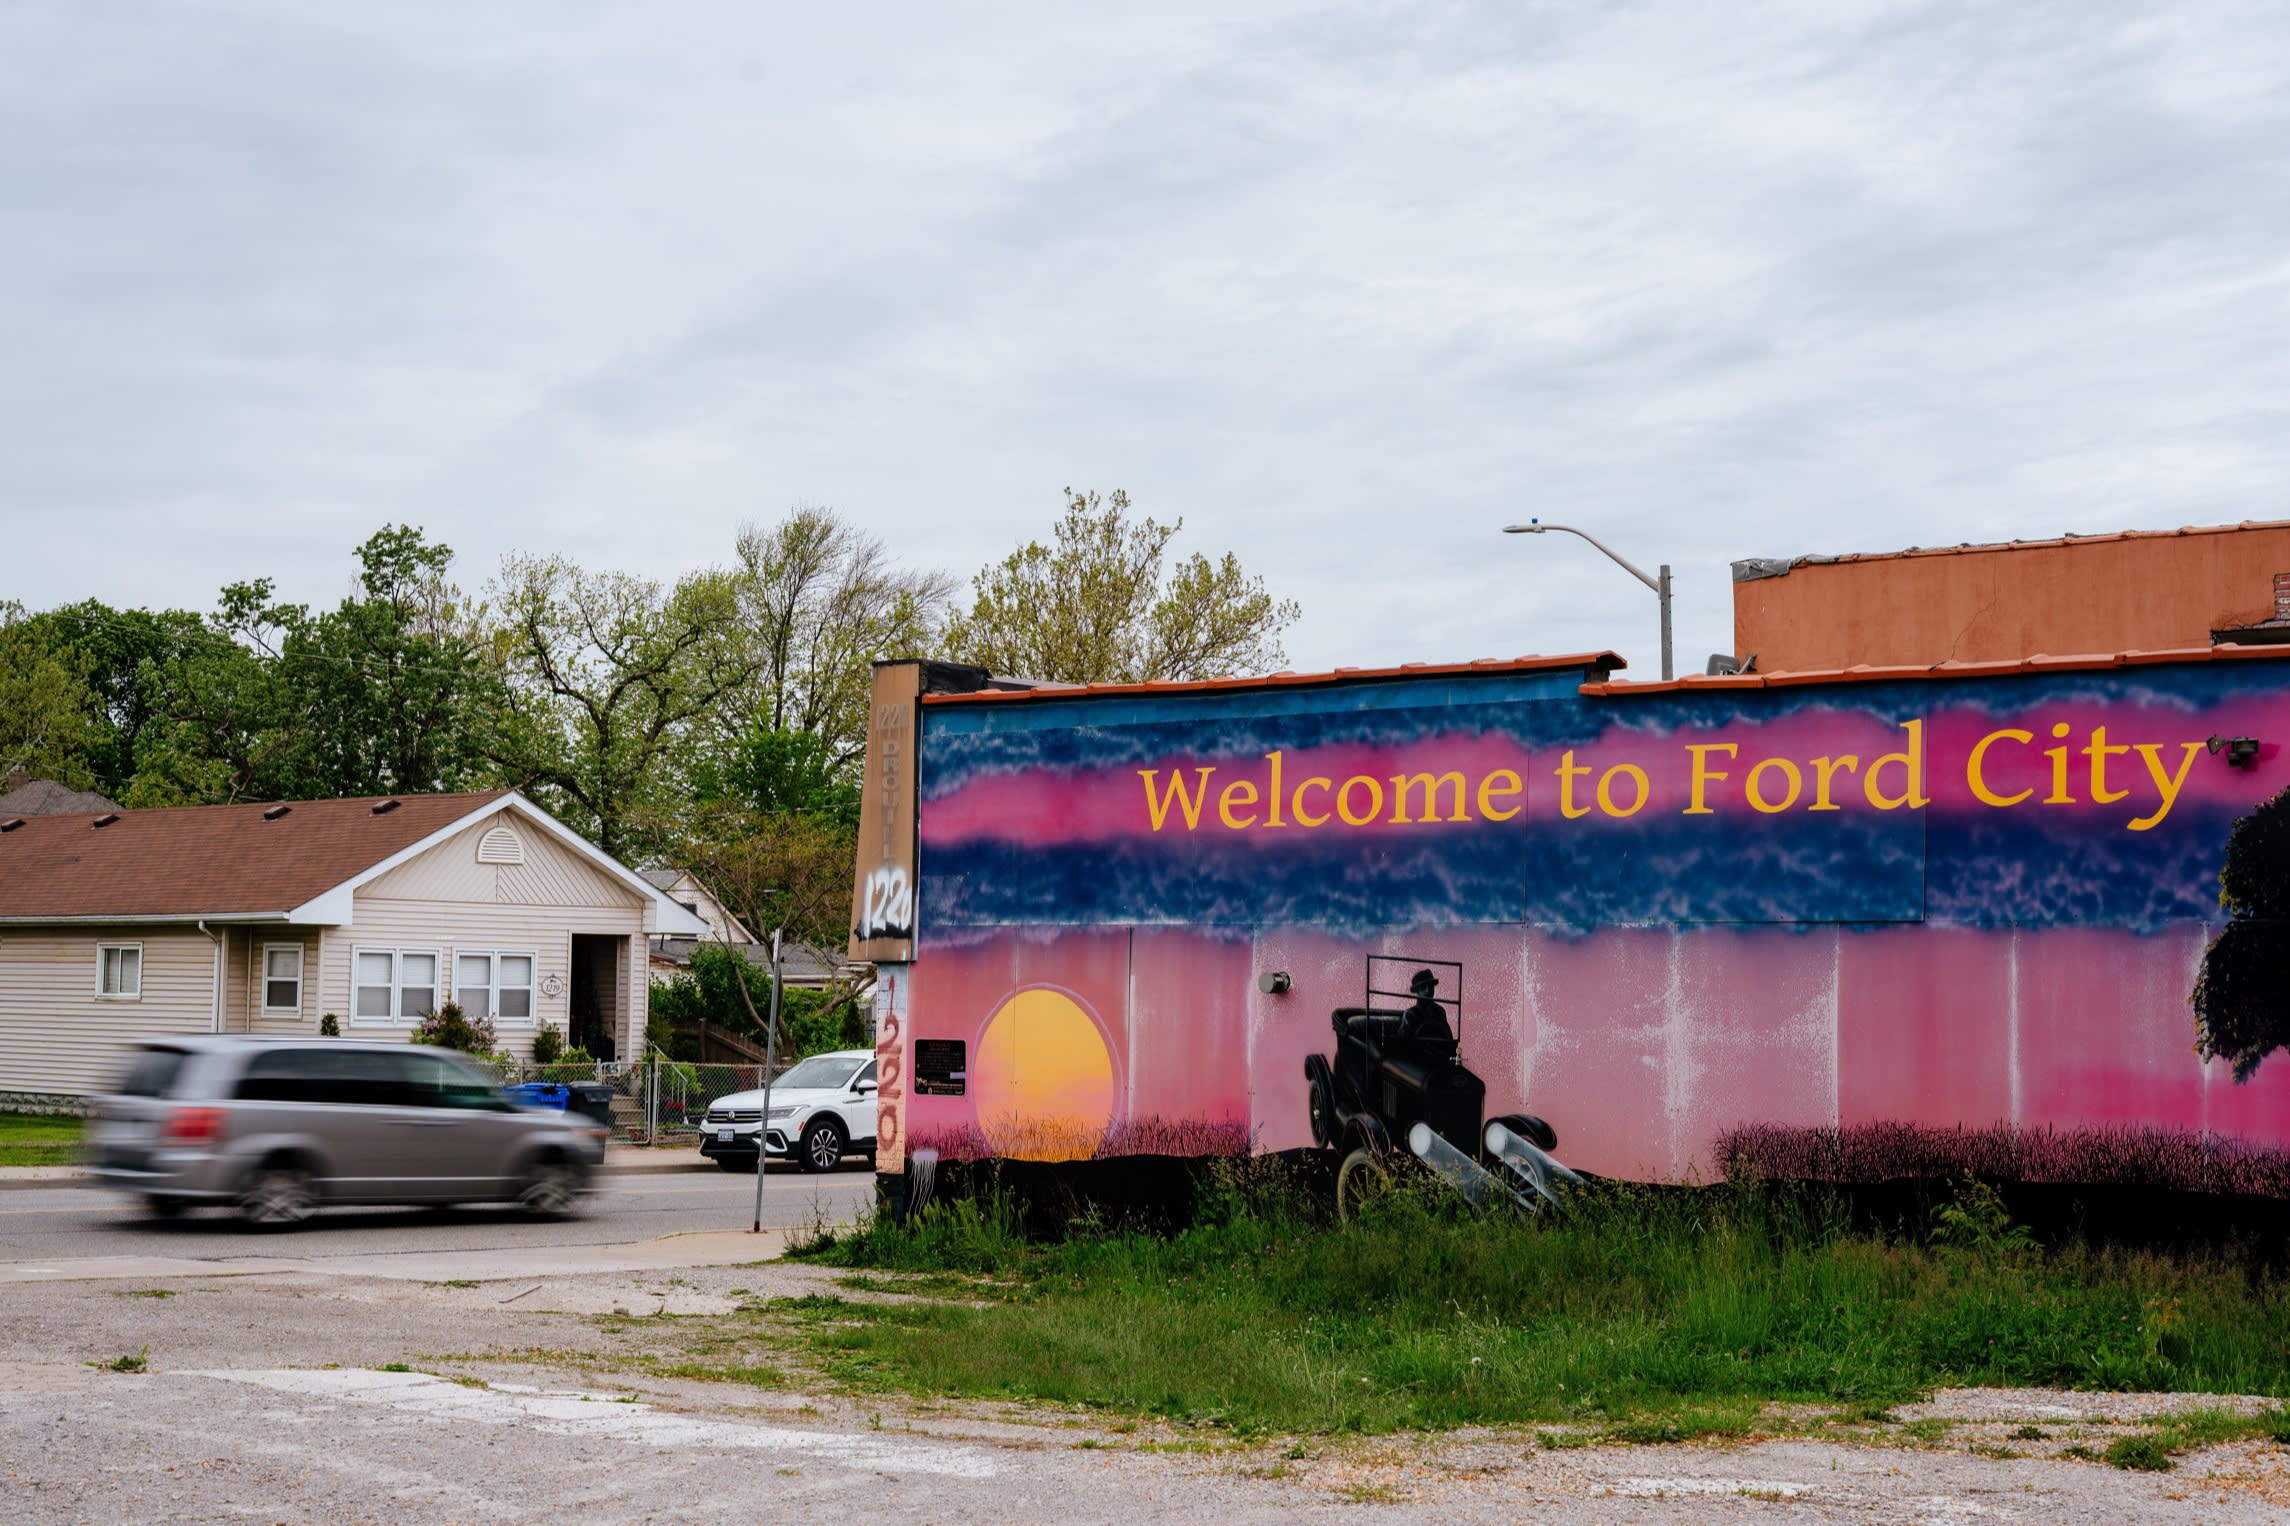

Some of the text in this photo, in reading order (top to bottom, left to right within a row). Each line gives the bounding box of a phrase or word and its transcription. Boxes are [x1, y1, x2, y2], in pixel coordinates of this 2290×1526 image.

[1137, 718, 2206, 831] Welcome to Ford City
[863, 867, 912, 939] 1220
[877, 975, 902, 1152] 1220
